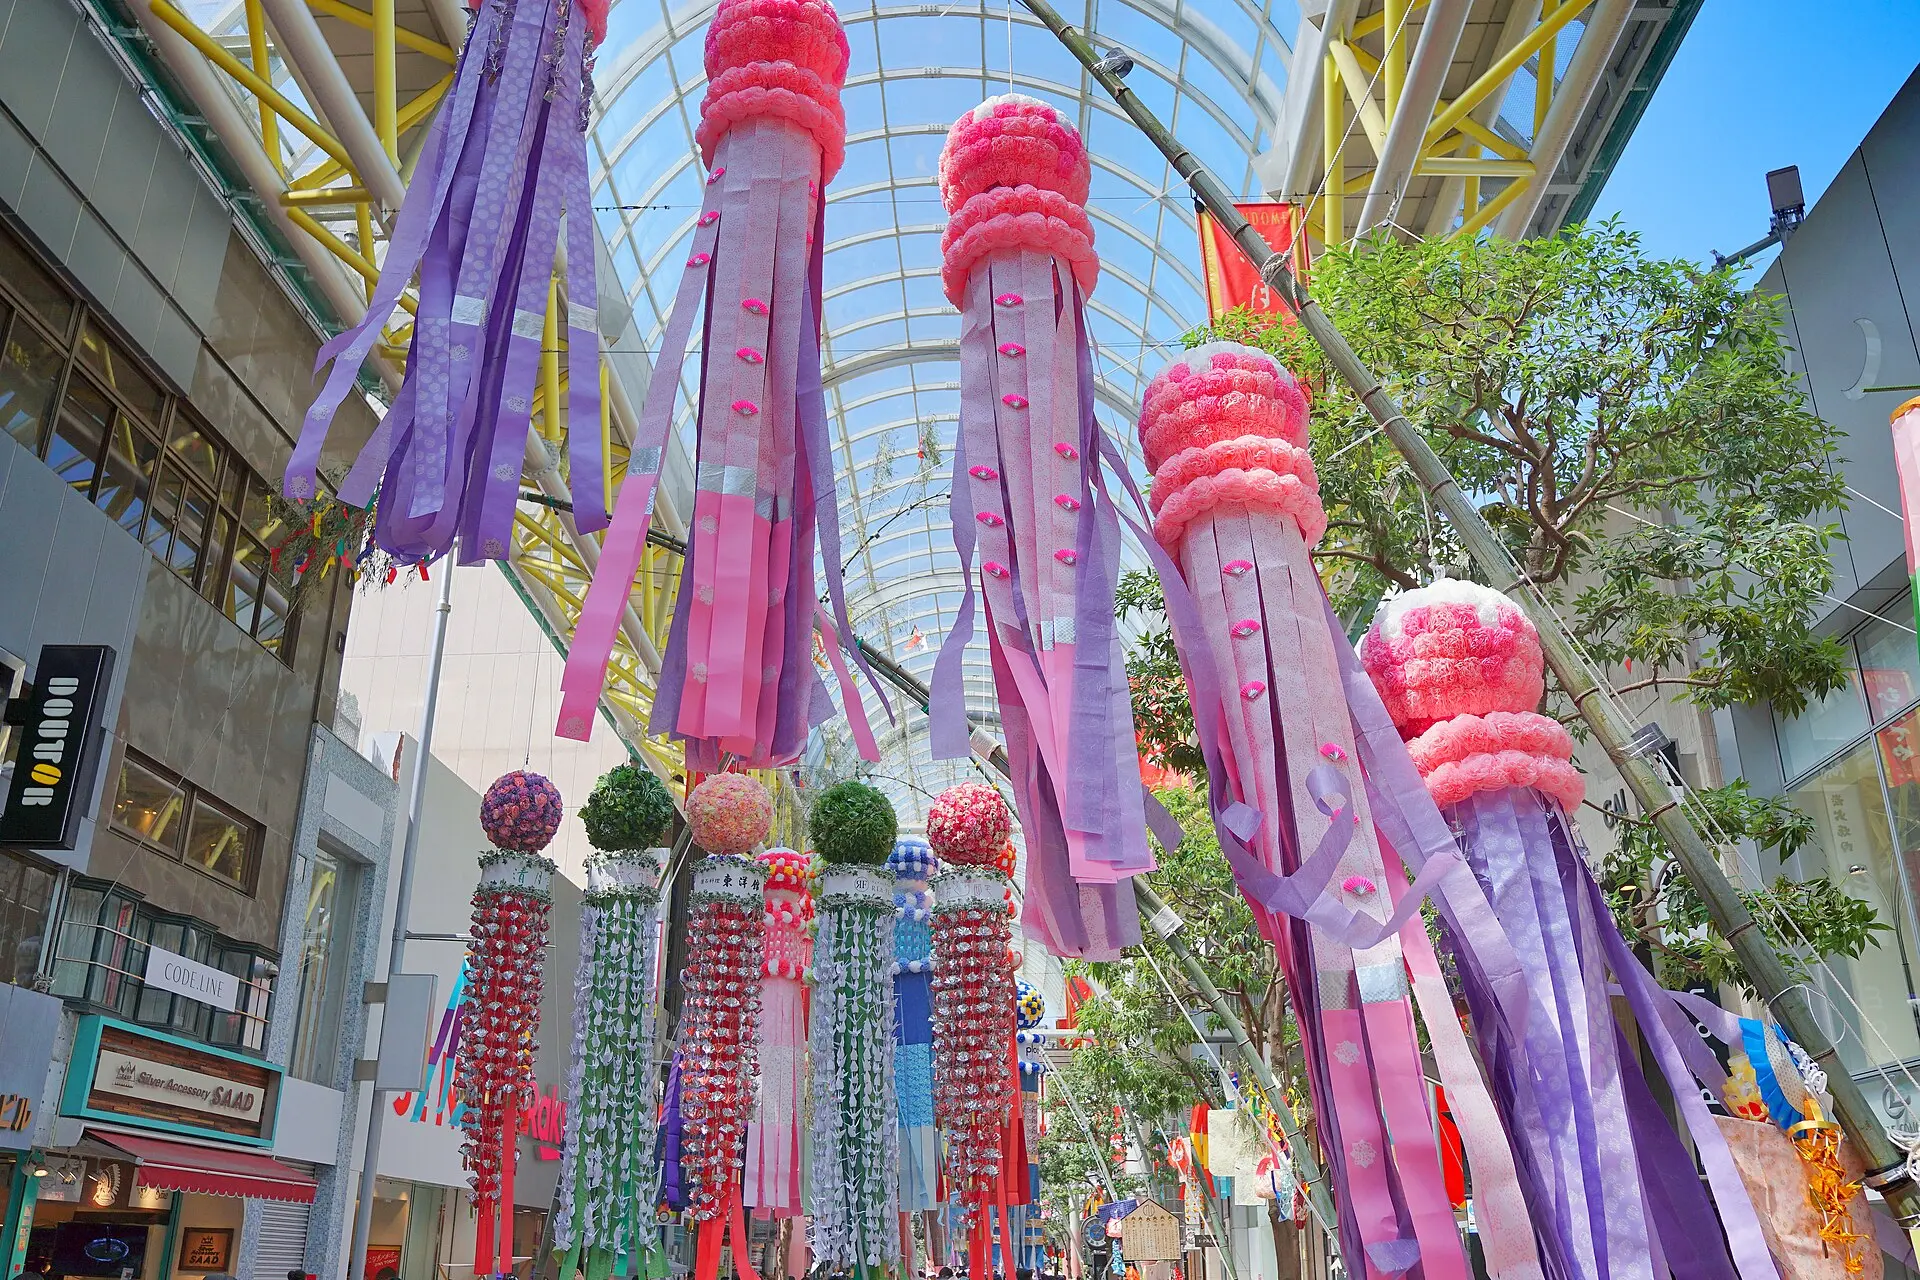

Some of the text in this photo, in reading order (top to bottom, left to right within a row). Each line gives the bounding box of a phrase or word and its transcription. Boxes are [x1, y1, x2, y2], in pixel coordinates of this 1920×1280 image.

[21, 677, 80, 807] DOUTOR
[164, 962, 225, 998] CODE.LINE
[137, 1071, 255, 1112] Silver Accessory SAAD
[189, 1255, 219, 1265] SAAD
